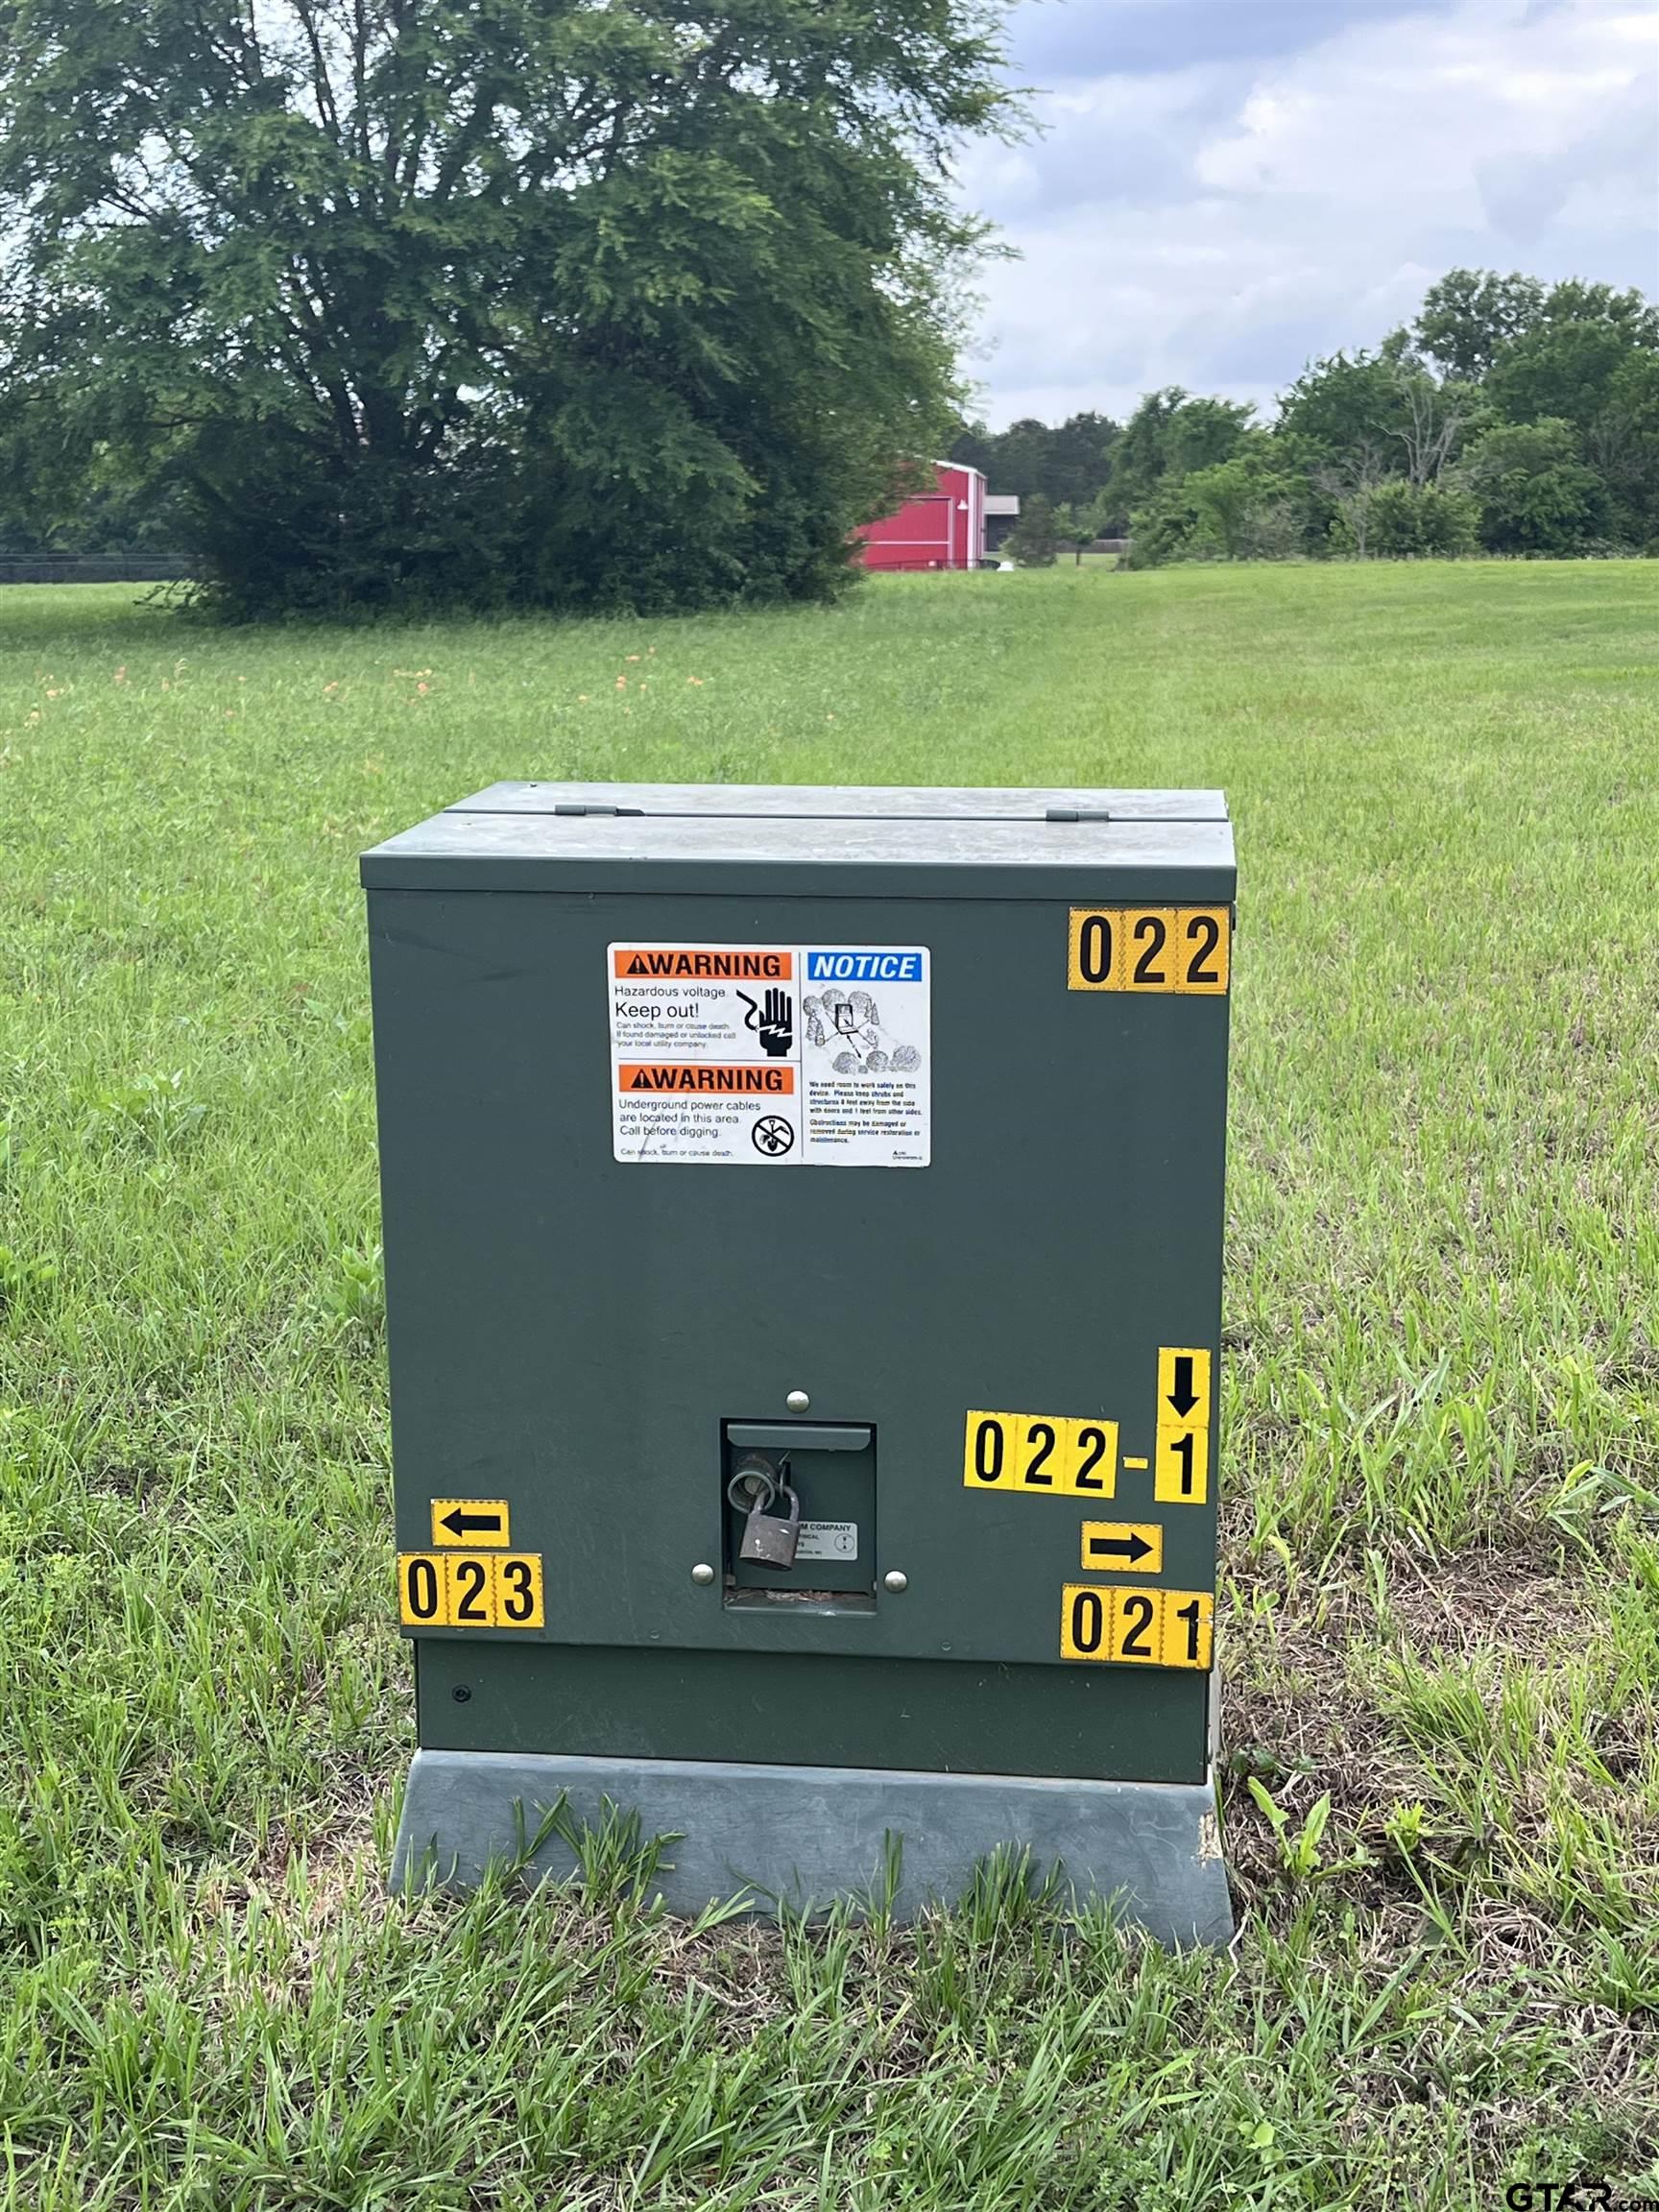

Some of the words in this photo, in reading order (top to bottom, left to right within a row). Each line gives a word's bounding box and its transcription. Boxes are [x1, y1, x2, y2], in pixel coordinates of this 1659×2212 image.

[1080, 915, 1219, 984] 022
[647, 953, 781, 976] WARNING
[814, 954, 915, 978] NOTICE
[614, 986, 679, 997] Hazardous
[615, 1001, 661, 1021] Keep
[666, 1002, 699, 1018] out!
[644, 1031, 679, 1040] damaged
[653, 1068, 783, 1091] WARNING
[618, 1099, 688, 1111] Underground
[690, 1101, 723, 1112] power
[726, 1100, 761, 1111] cables
[639, 1113, 678, 1122] located
[681, 1113, 690, 1122] in
[693, 1114, 712, 1123] this
[620, 1125, 640, 1136] Call
[643, 1125, 677, 1136] before
[680, 1126, 721, 1138] digging.
[408, 1558, 534, 1621] 023
[1071, 1591, 1199, 1660] 021
